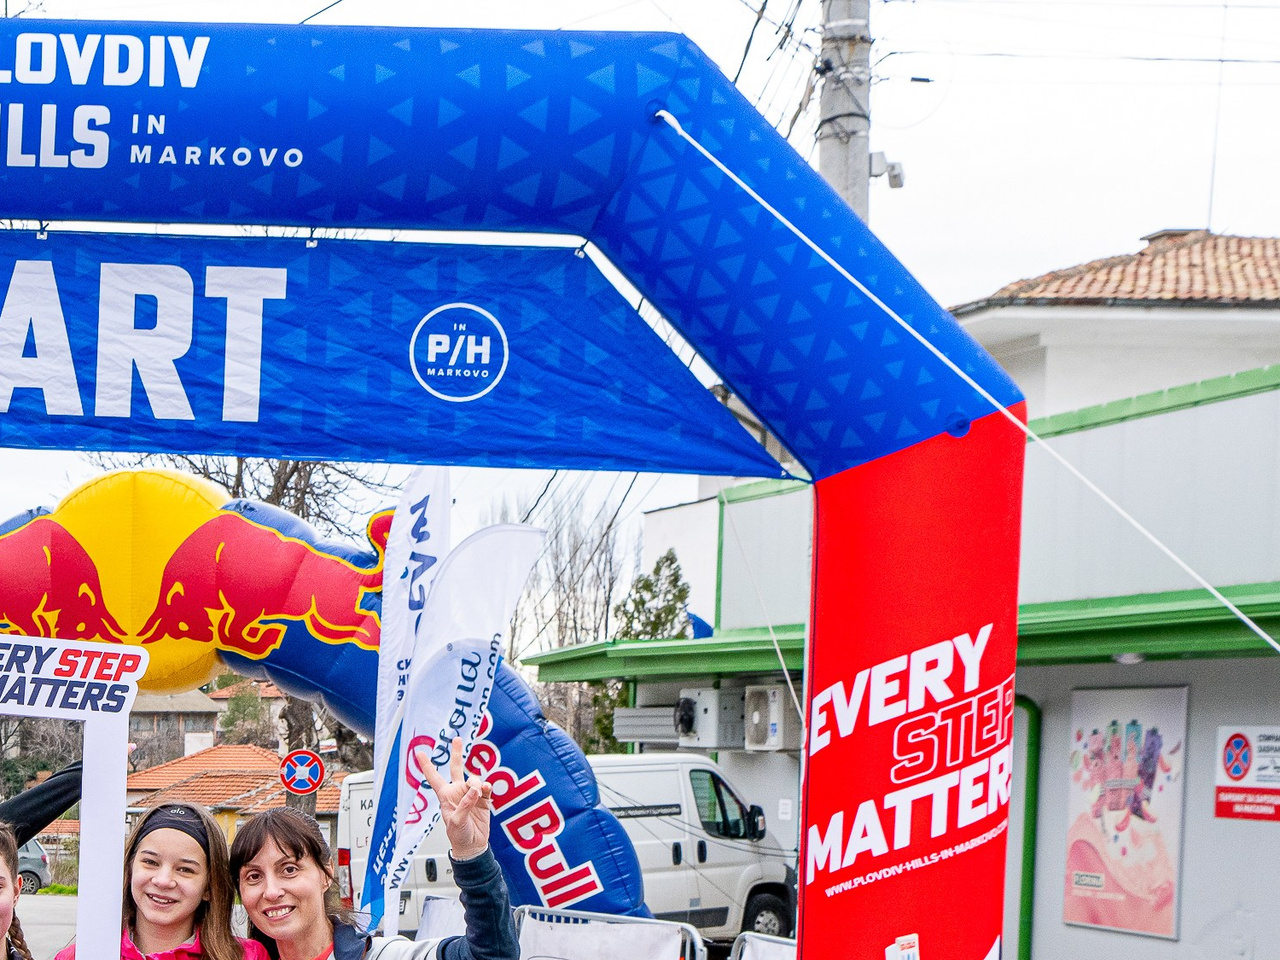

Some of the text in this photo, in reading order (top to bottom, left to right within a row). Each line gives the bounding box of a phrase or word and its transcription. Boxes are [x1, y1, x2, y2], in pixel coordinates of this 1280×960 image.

[131, 113, 165, 136] IN
[129, 145, 304, 168] MARKOVO
[453, 322, 467, 331] IN
[427, 333, 491, 366] P/H
[426, 367, 489, 378] MARKOVO
[53, 648, 142, 681] STEP
[809, 622, 994, 757] EVERY
[890, 671, 1016, 784] STEP
[464, 714, 546, 811] ed
[506, 794, 602, 909] Bull
